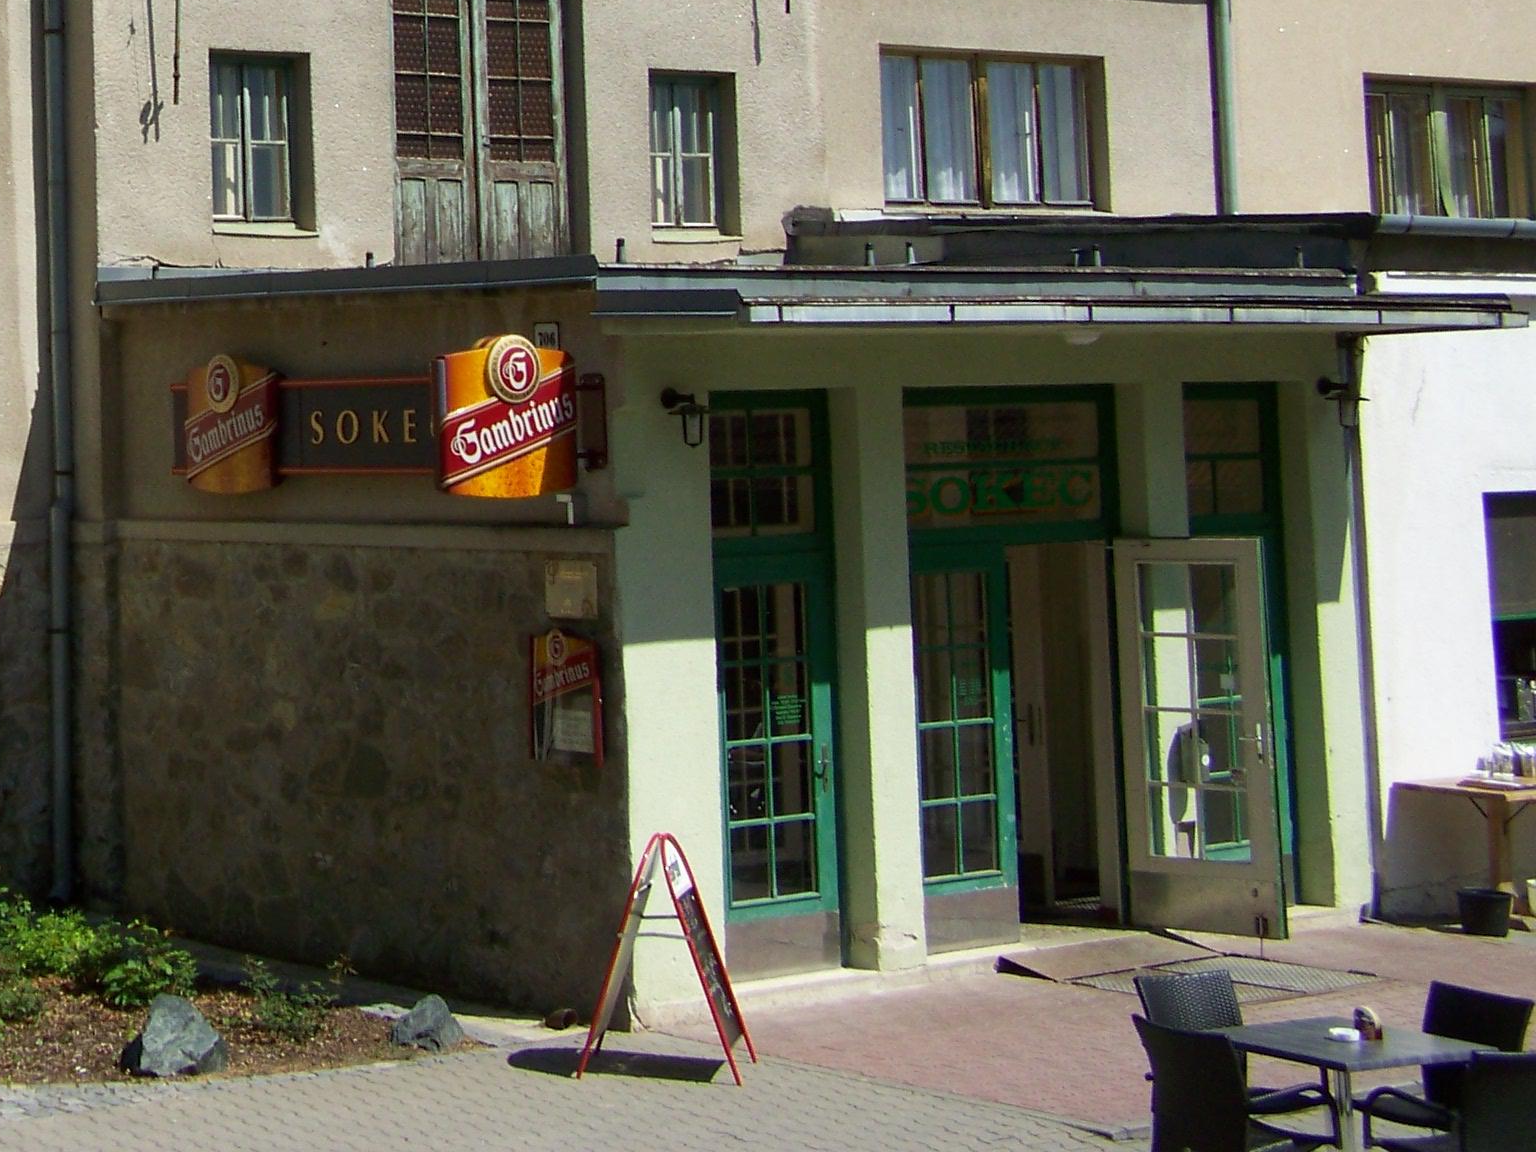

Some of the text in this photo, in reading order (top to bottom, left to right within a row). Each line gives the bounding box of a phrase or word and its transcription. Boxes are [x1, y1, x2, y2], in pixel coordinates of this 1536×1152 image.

[187, 404, 264, 463] Gambrinus
[310, 409, 435, 444] SOKE
[450, 393, 573, 464] Gambrinus
